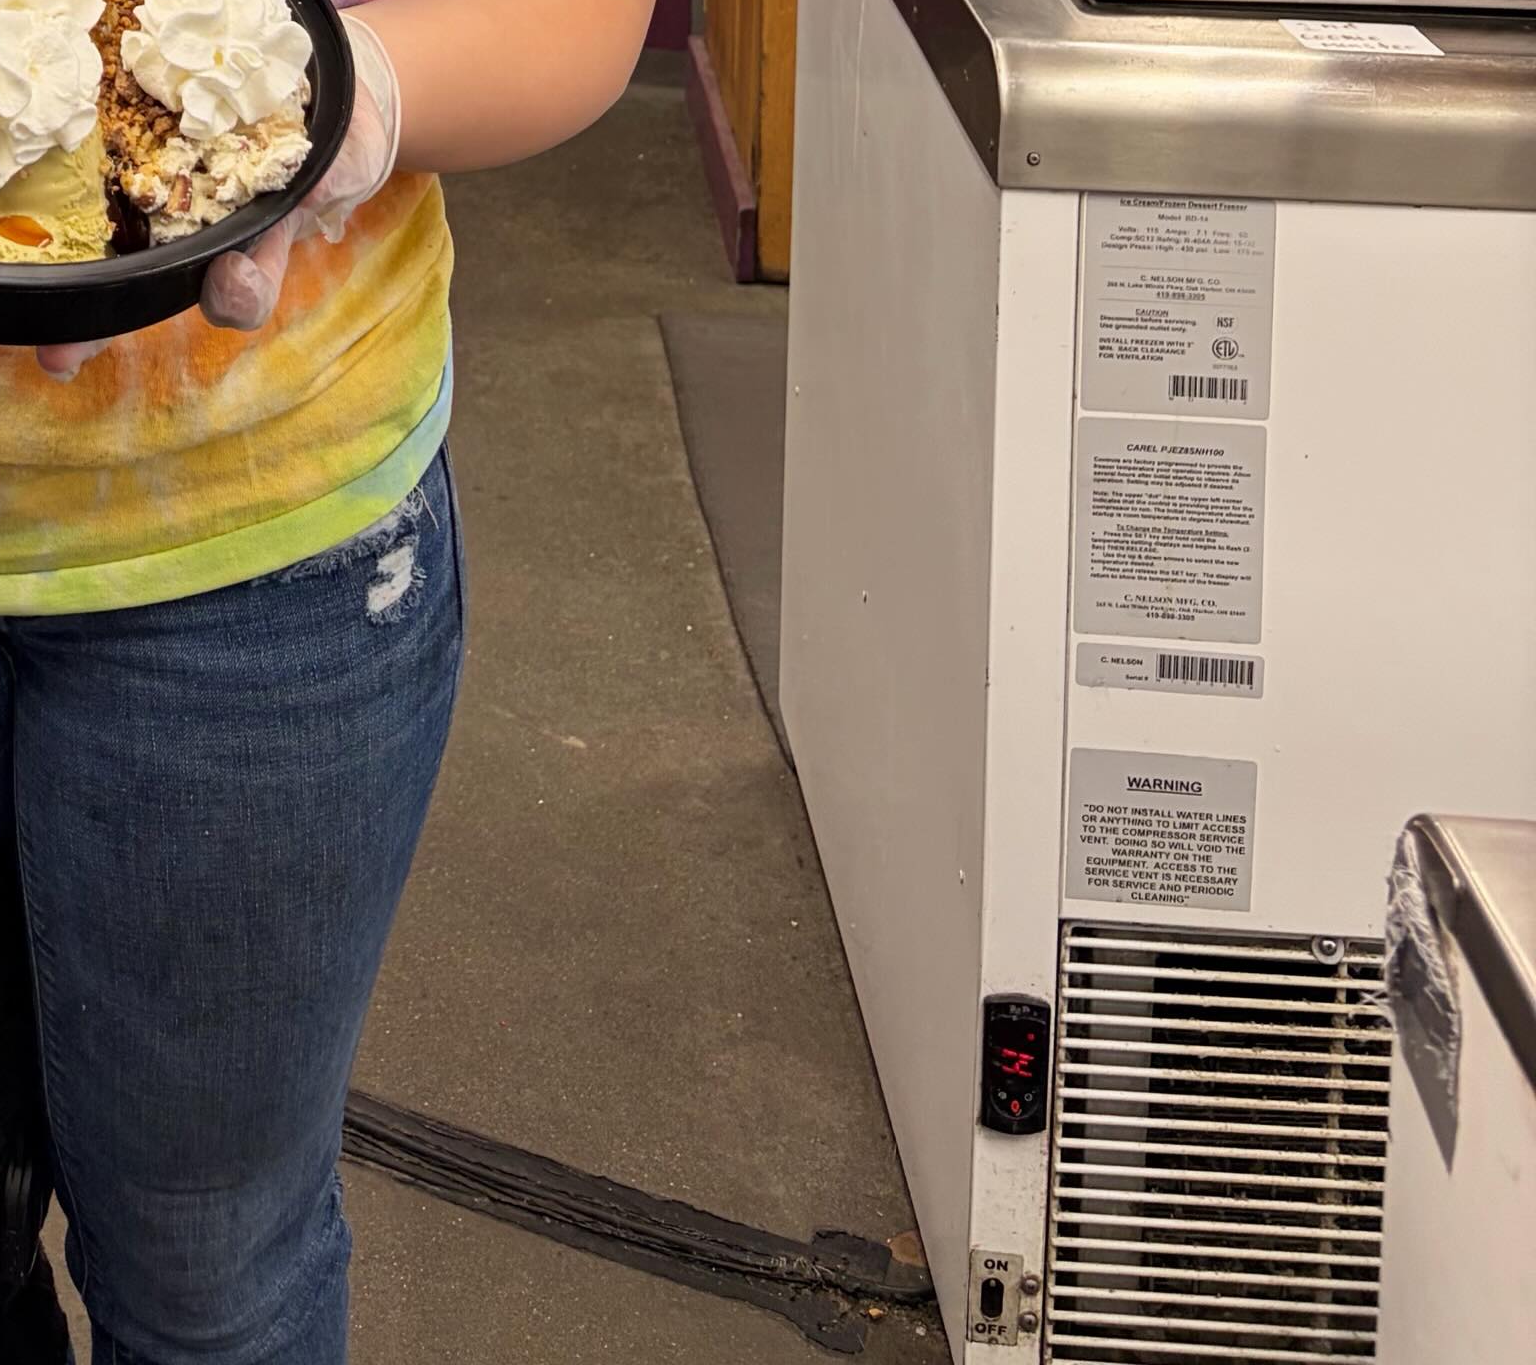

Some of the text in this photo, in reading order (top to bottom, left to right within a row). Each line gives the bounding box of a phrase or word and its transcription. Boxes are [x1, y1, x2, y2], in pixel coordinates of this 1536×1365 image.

[1120, 198, 1132, 207] Ice
[1188, 200, 1217, 210] Dessert
[1151, 275, 1184, 283] NELSON
[1135, 308, 1169, 317] CAUTION
[1099, 337, 1128, 345] INSTALL
[1131, 339, 1165, 347] FREEZER
[1116, 354, 1163, 362] VENTILATION
[1141, 347, 1186, 356] CLEARANCE
[1127, 444, 1158, 454] CAREL
[1124, 594, 1133, 602] C.
[1135, 595, 1173, 604] NELSON
[1111, 657, 1143, 666] NELSON
[1127, 776, 1202, 794] WARNING
[1107, 806, 1129, 815] NOT
[1131, 807, 1173, 819] INSTALL
[1176, 810, 1213, 822] WATER
[1216, 813, 1247, 824] LINES
[1081, 814, 1246, 835] OR ANYTHING TO LIMIT ACCESS
[1082, 825, 1245, 845] TO THE COMPRESSOR SERVICE
[1080, 835, 1246, 855] VENT. DOING SO WILL VOID THE
[1111, 848, 1212, 863] WARRANTY ON THE
[1086, 857, 1238, 876] EQUIPMENT. ACCESS TO THE
[1085, 867, 1238, 886] SERVICE VENT IS NECESSARY
[1088, 878, 1234, 897] FOR SERVICE AND PERIODIC
[984, 1259, 1009, 1272] ON
[975, 1323, 1008, 1337] OFF
